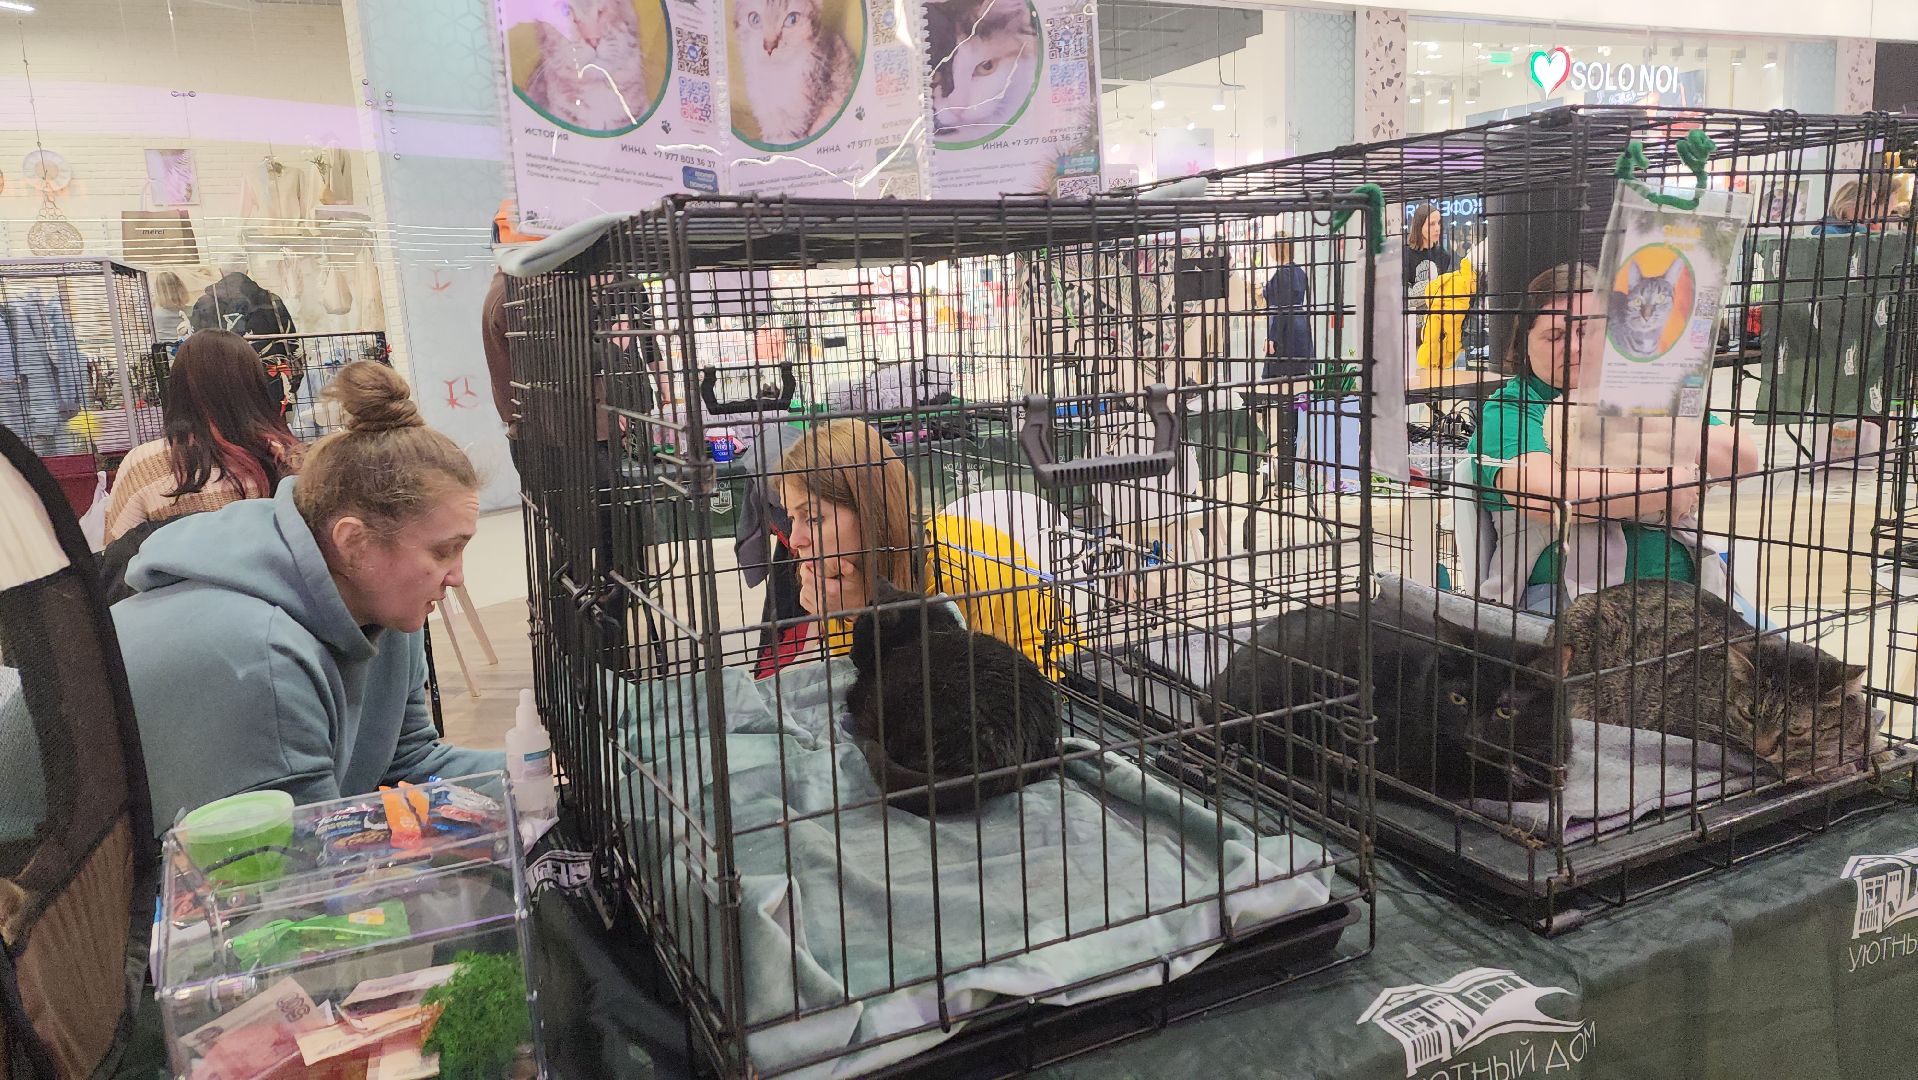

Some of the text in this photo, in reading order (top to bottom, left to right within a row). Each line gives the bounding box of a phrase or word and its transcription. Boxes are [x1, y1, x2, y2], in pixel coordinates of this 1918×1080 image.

[1571, 62, 1679, 94] SOLO NOI
[524, 127, 569, 141] ИСТОРИЯ
[982, 140, 1009, 150] ИННА
[1023, 137, 1039, 146] 977
[1041, 135, 1057, 144] 803
[621, 143, 647, 156] ИННА
[665, 151, 679, 161] 977
[680, 154, 695, 165] 803
[816, 145, 841, 155] ИННА
[858, 138, 872, 149] 977
[1545, 1020, 1597, 1075] ДОМ
